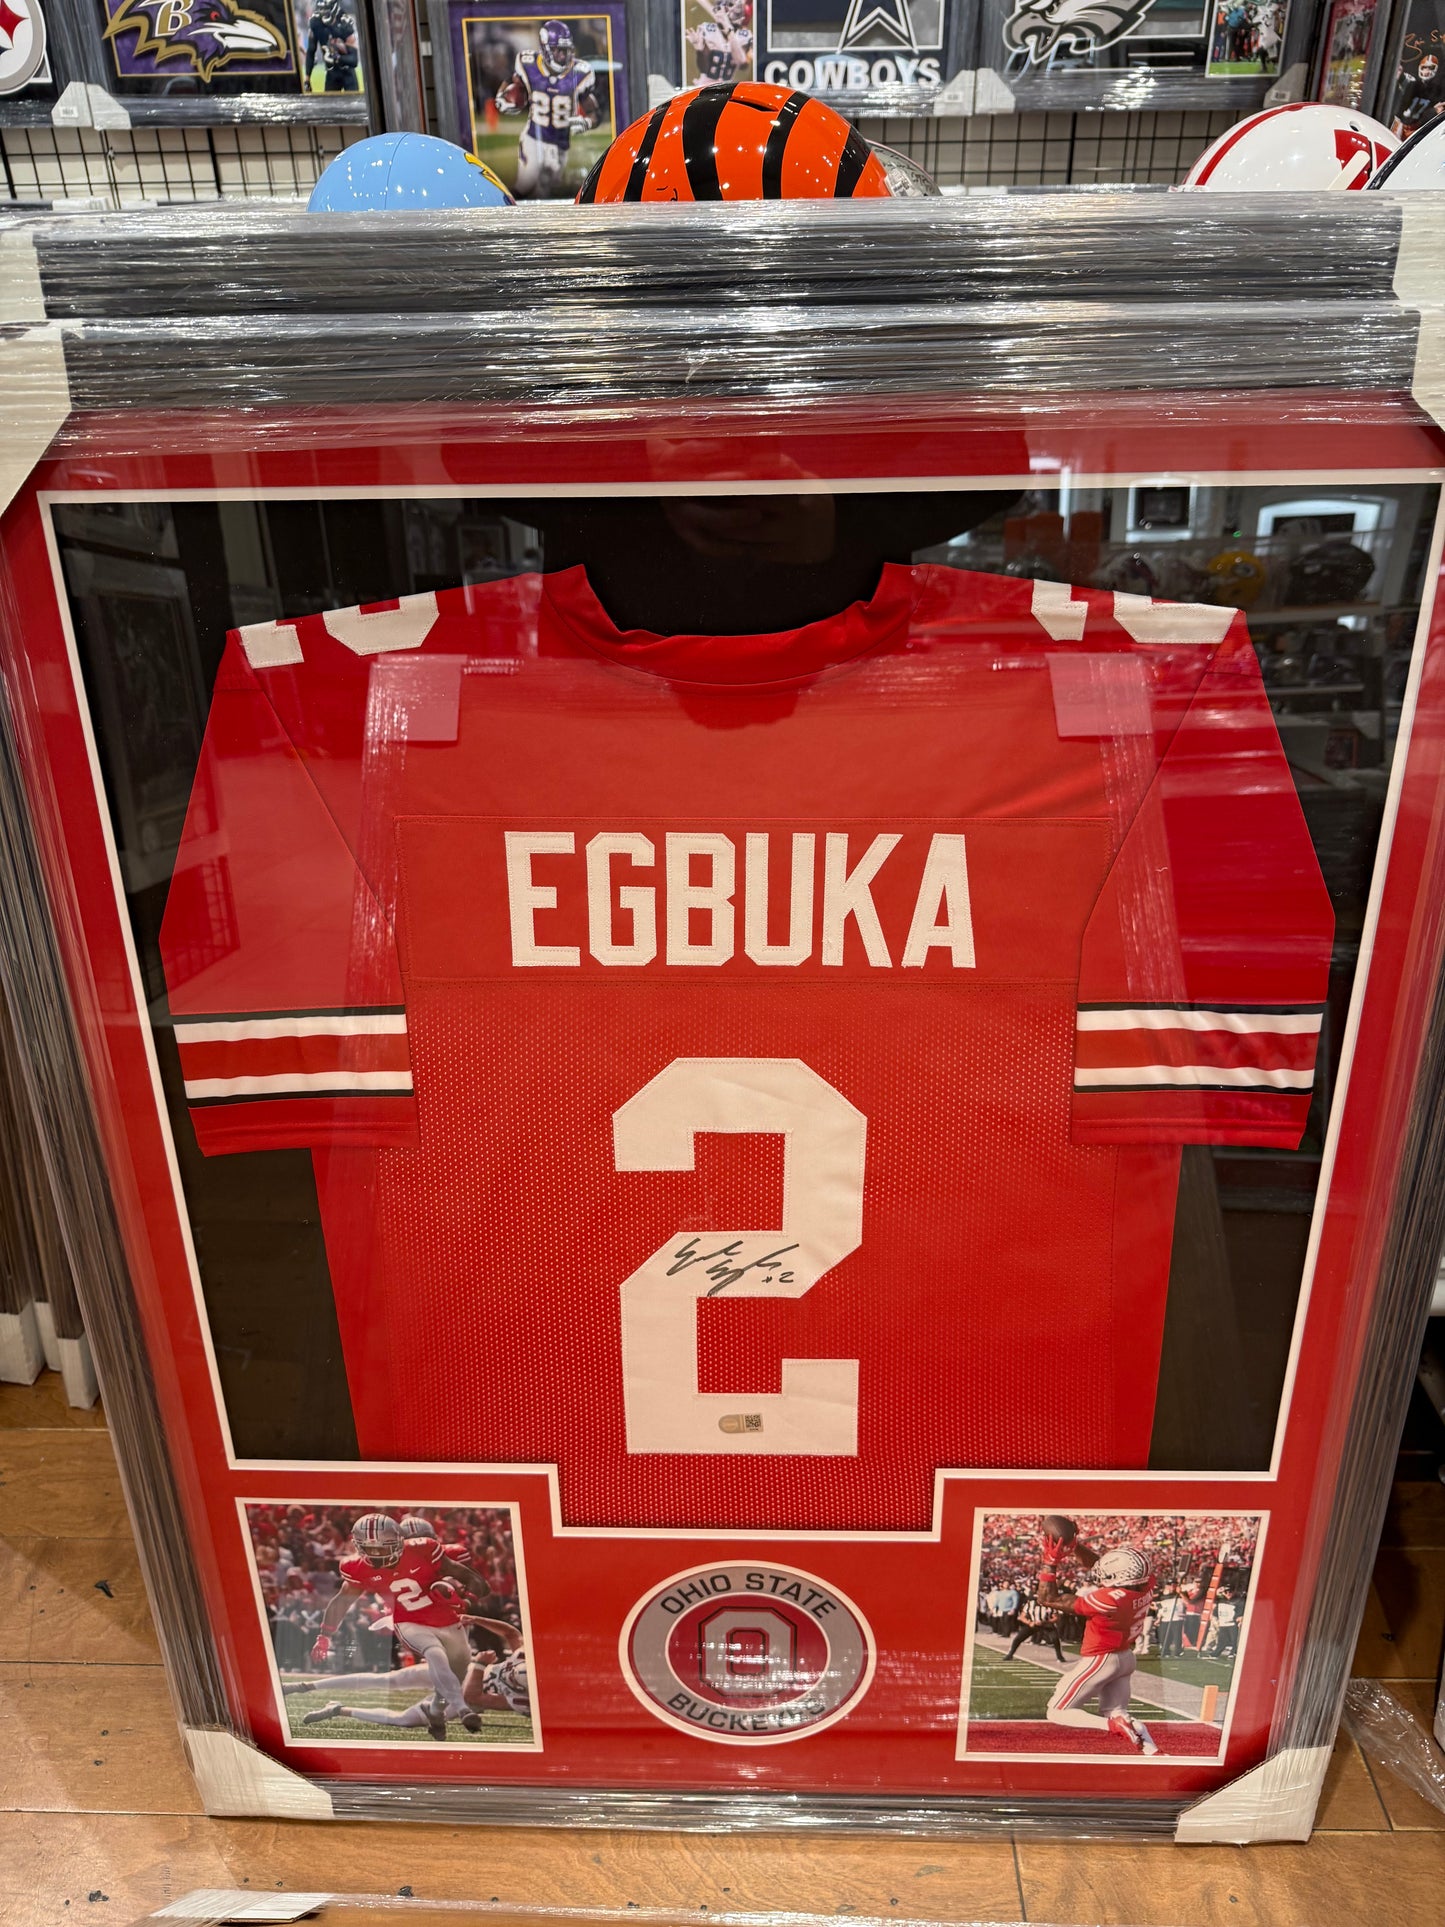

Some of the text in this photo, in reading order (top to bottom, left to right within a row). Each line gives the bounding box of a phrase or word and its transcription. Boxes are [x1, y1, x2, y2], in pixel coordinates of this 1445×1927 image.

[155, 0, 192, 37] B
[764, 57, 942, 91] COWBOYS
[532, 91, 571, 129] 28
[504, 831, 977, 969] EGBUKA
[611, 1057, 868, 1458] 2
[389, 1577, 433, 1612] 2
[660, 1572, 838, 1619] OHIO STATE
[697, 1606, 797, 1698] O
